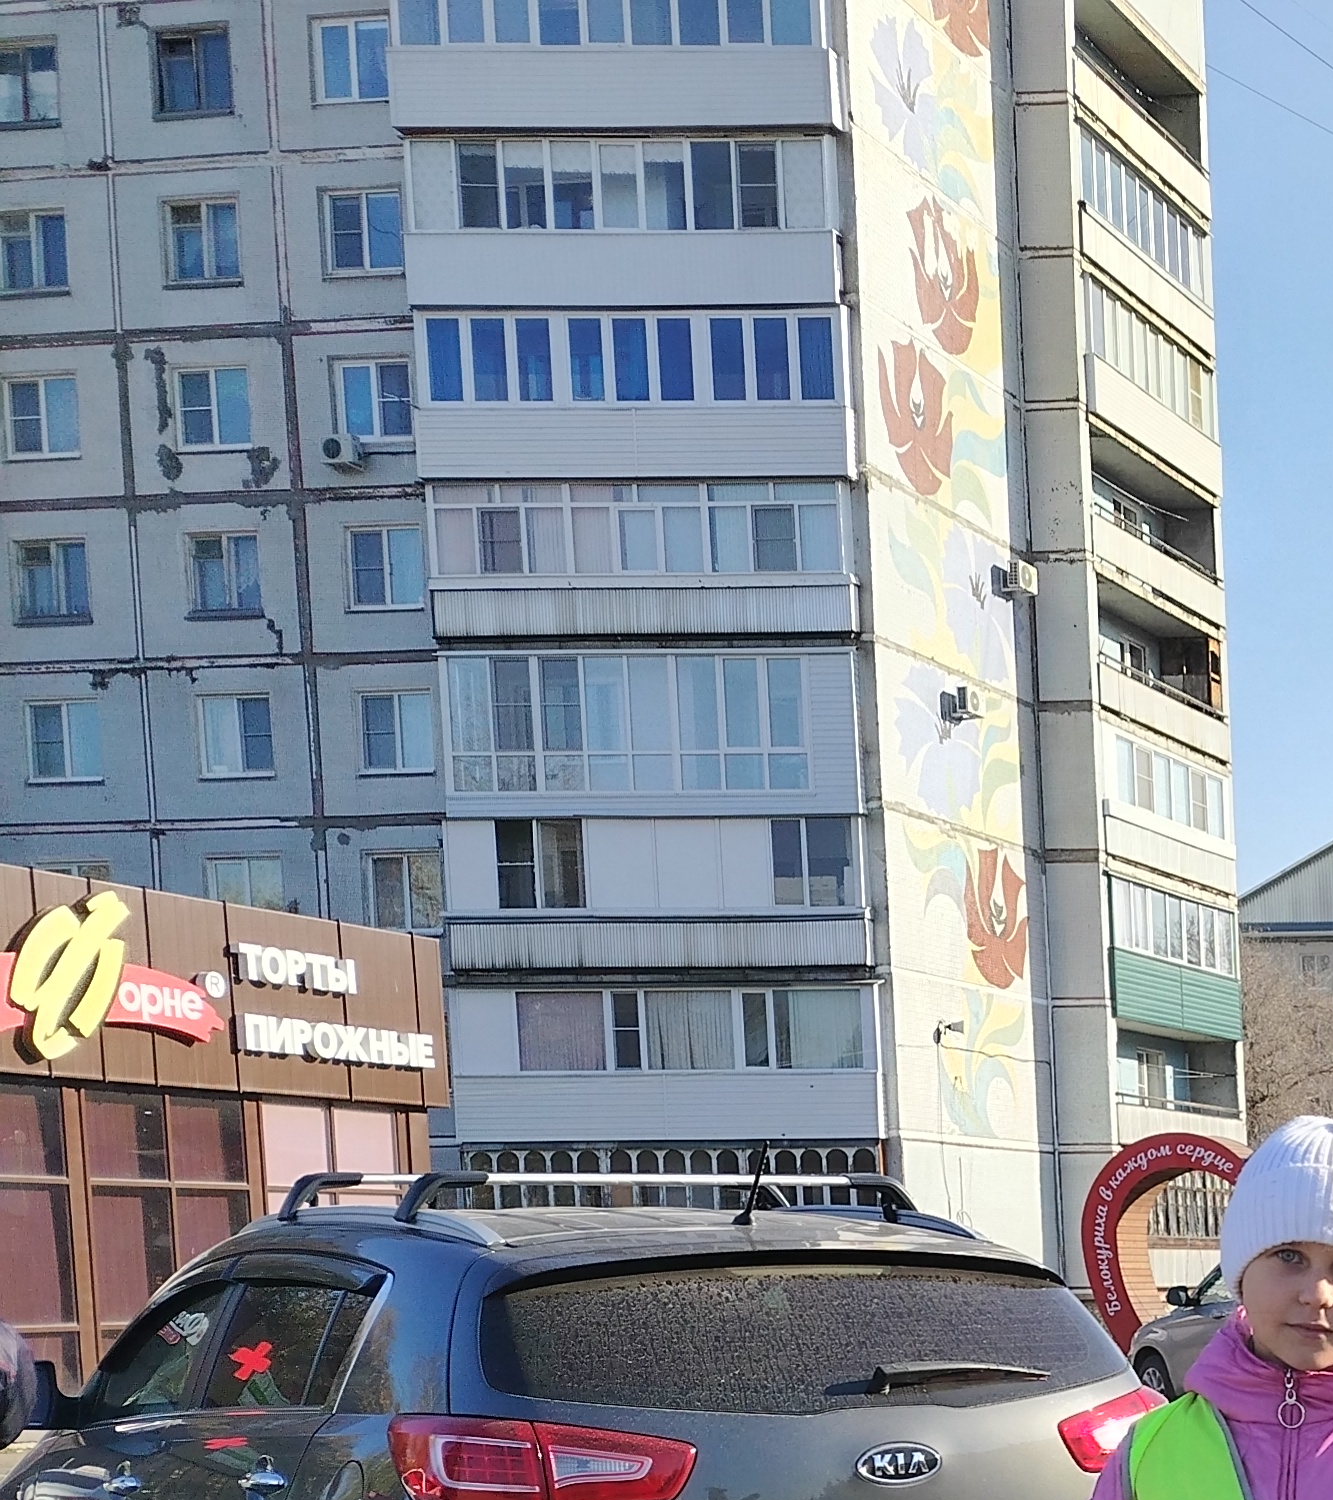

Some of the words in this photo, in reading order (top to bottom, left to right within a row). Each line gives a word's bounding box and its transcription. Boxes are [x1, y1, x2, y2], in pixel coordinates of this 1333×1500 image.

[239, 943, 357, 994] ТОРТЫ
[244, 1013, 435, 1068] ПИРОЖНЫЕ
[1109, 1144, 1172, 1189] каждом
[1177, 1143, 1234, 1174] сердце
[1099, 1186, 1114, 1202] в
[1094, 1205, 1121, 1316] Белокуриха
[872, 1451, 929, 1475] KIA
